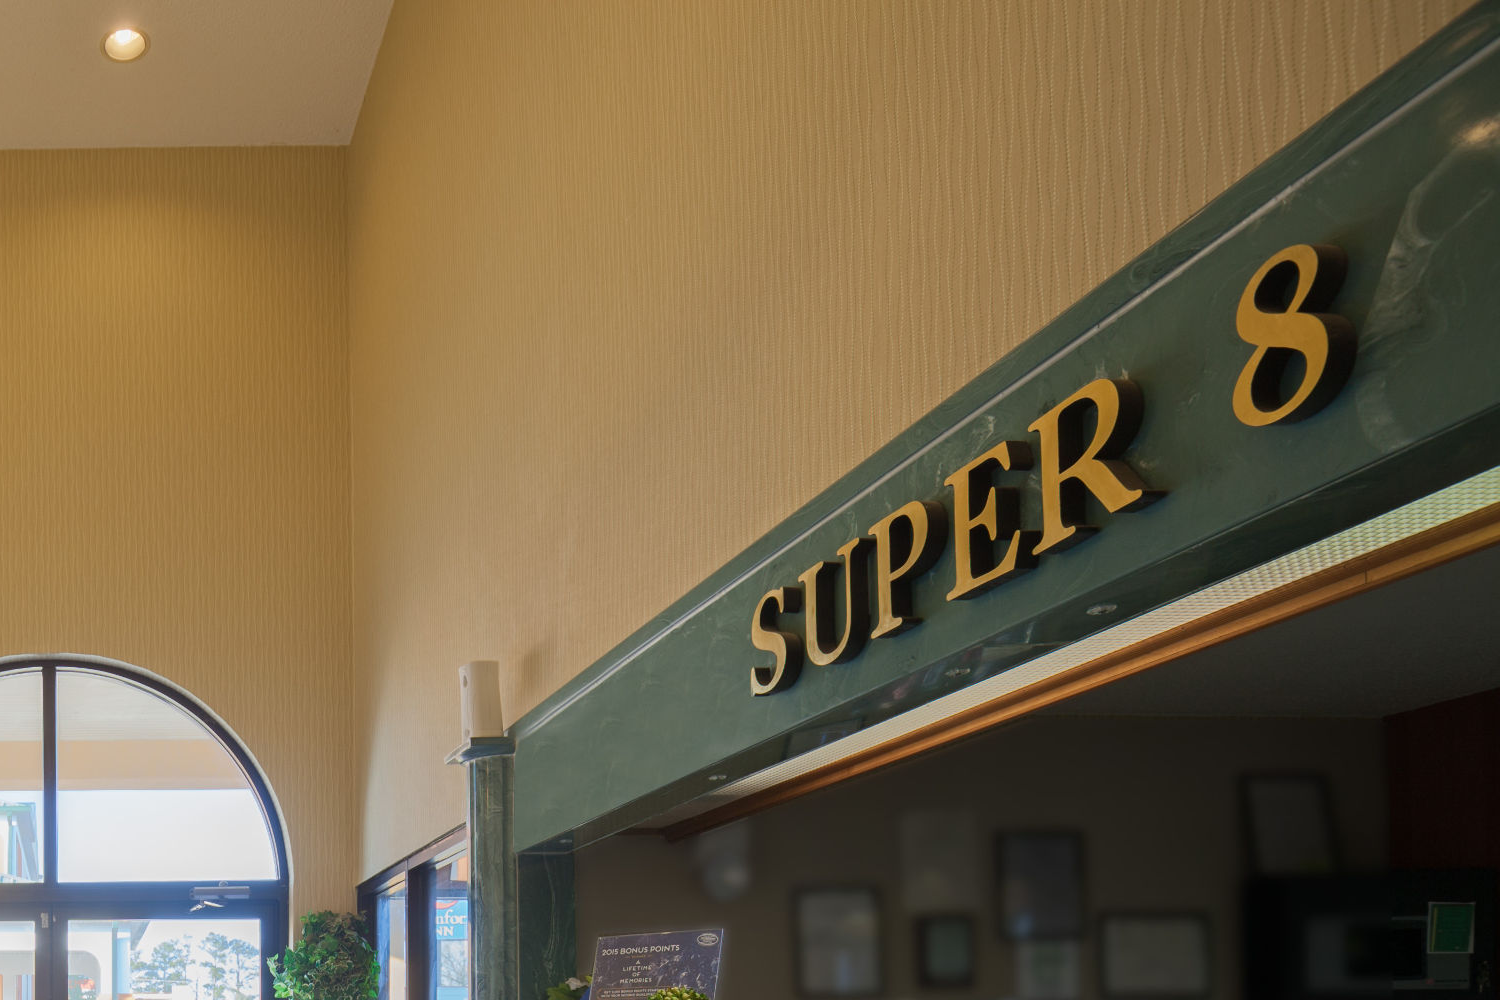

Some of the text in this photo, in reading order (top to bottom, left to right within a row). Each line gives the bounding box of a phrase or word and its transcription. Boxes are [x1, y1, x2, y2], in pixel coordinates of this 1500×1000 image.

[750, 243, 1348, 698] SUPER 8
[602, 944, 680, 956] 2015 BONUS POINTS
